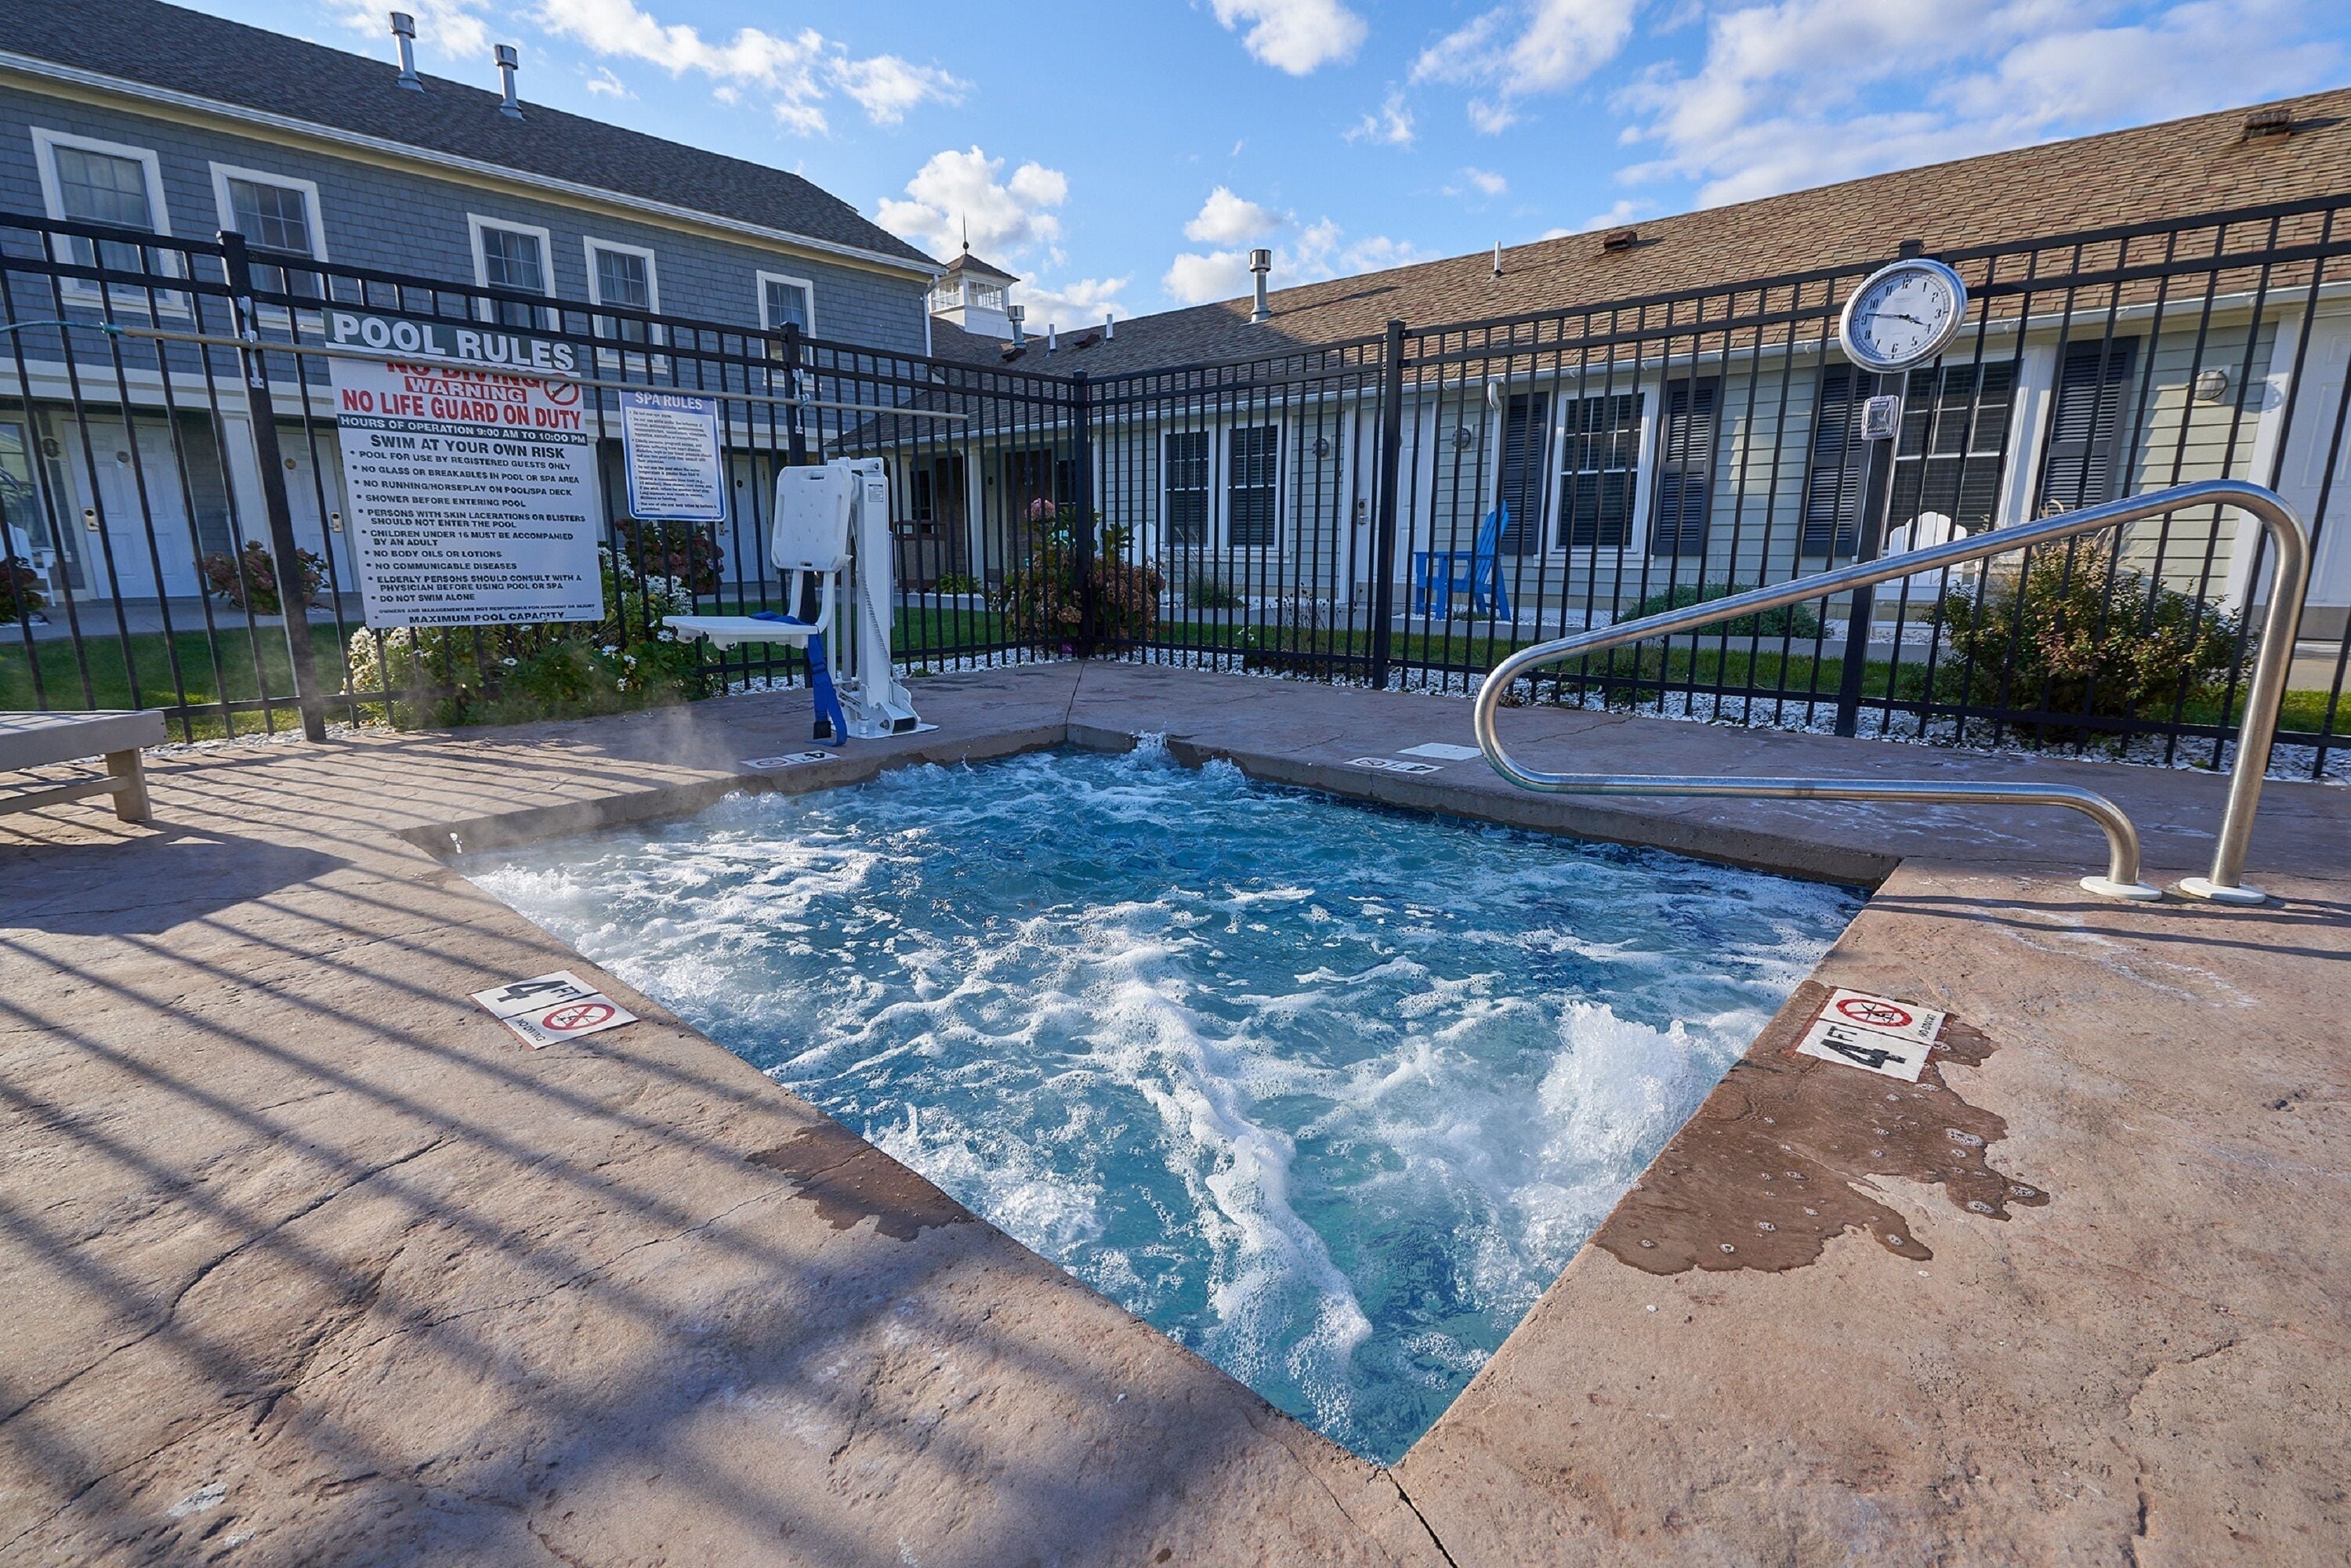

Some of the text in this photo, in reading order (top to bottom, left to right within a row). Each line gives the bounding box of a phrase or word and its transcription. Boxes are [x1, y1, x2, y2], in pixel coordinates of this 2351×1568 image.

[1902, 279, 1912, 289] 12
[1923, 282, 1927, 292] 1
[1886, 285, 1893, 296] 11
[1932, 292, 1939, 302] 2
[1869, 299, 1879, 310] 10
[1935, 308, 1942, 319] 3
[1861, 315, 1867, 325] 9
[1925, 324, 1932, 334] 4
[1865, 330, 1871, 340] 8
[332, 313, 574, 371] POOL RULES
[1875, 339, 1881, 349] 7
[1911, 336, 1918, 346] 5
[1891, 343, 1898, 353] 6
[409, 377, 524, 403] WARNING
[636, 391, 702, 410] SPA RULES
[342, 389, 581, 430] NO LIFE GUARD ON DUTY
[339, 416, 585, 444] HOURS OF OPERATION 9:00 AM TO 10:00 PM
[369, 434, 565, 458] SWIM AT YOUR OWN RISK
[359, 451, 571, 470] POOL FOR USE BY REGISTERED GUESTS ONLY
[360, 465, 376, 474] NO
[378, 466, 410, 476] GLASS
[411, 468, 426, 476] OR
[427, 469, 488, 479] BREAKABLES
[500, 473, 524, 481] POOL
[539, 474, 556, 483] SPA
[557, 475, 579, 483] AREA
[363, 480, 379, 488] NO
[380, 480, 487, 492] RUNNING/HORSEPLAY
[503, 486, 547, 494] POOL/SPA
[549, 487, 573, 496] DECK
[364, 494, 409, 503] SHOWER
[411, 496, 451, 505] BEFORE
[451, 498, 499, 506] ENTERING
[367, 509, 415, 518] PERSONS
[415, 510, 440, 519] WITH
[468, 512, 531, 520] LACERATIONS
[370, 517, 413, 526] SHOULD
[437, 519, 469, 527] ENTER
[369, 529, 420, 538] CHILDREN
[373, 538, 387, 546] BY
[408, 614, 470, 624] MAXIMUM
[473, 613, 505, 621] POOL
[496, 980, 569, 1002] 4
[550, 986, 582, 998] FT
[1827, 1025, 1858, 1042] FT
[1820, 1038, 1907, 1070] 4
